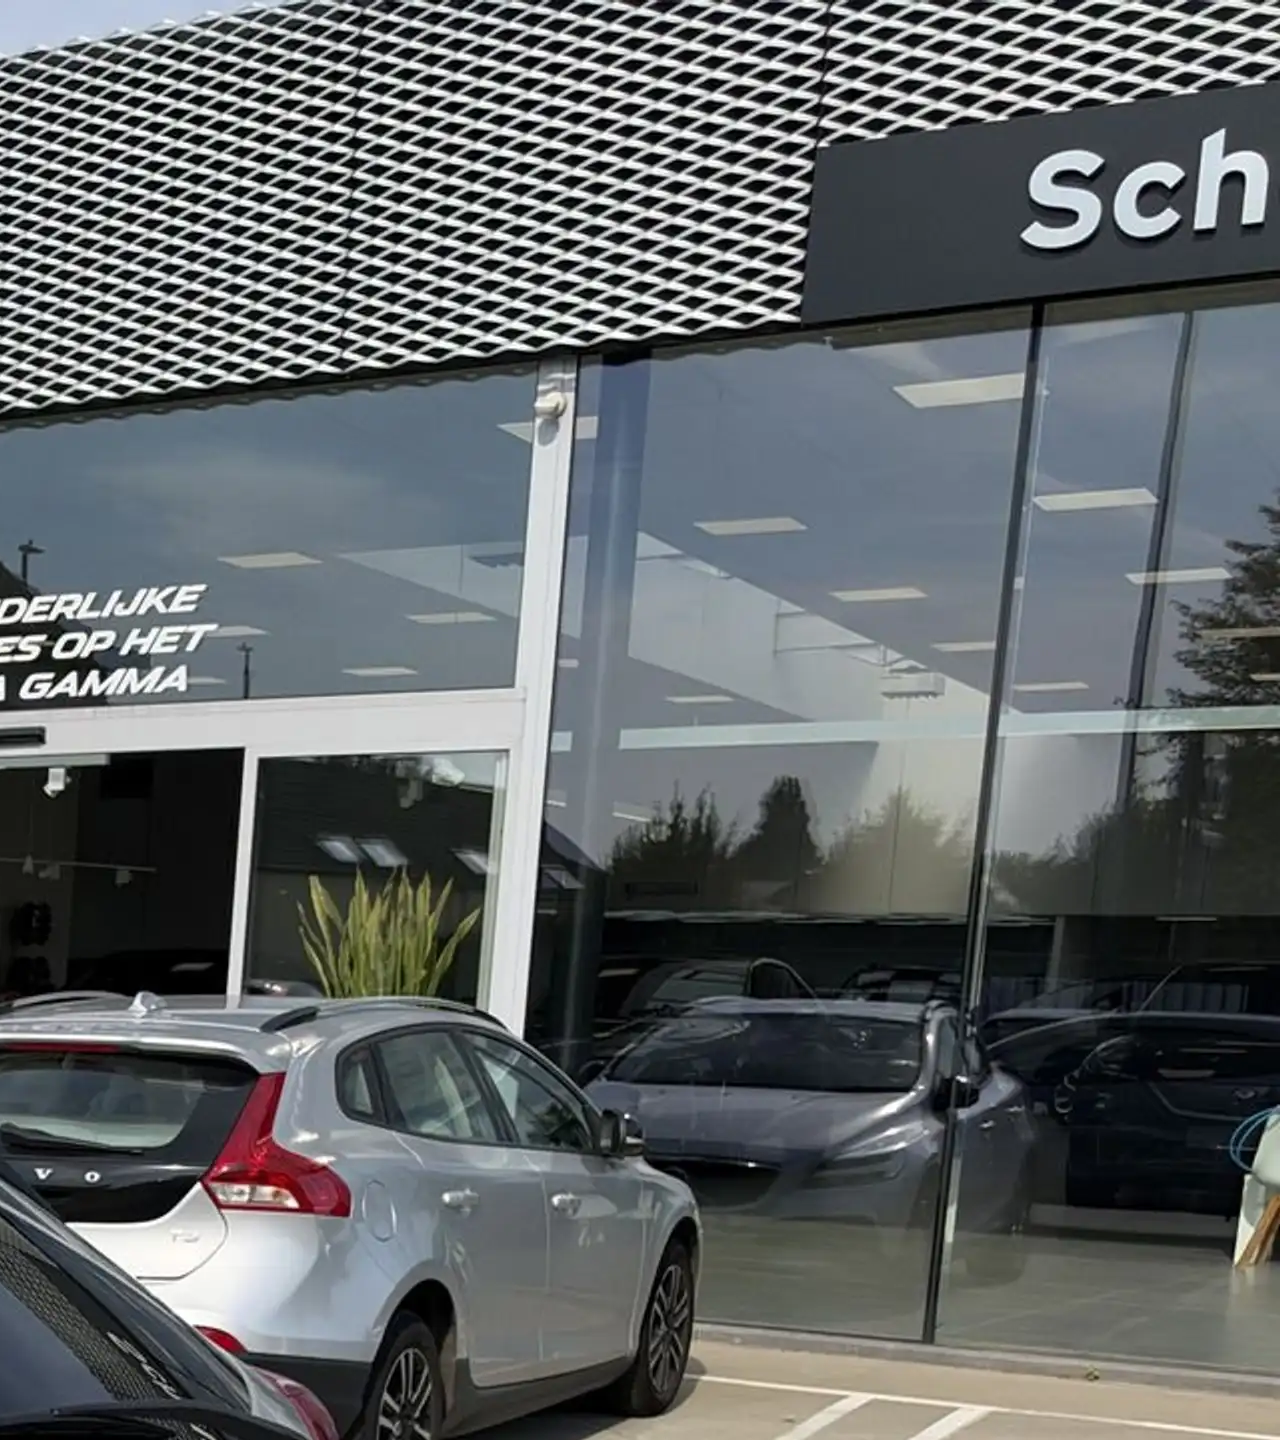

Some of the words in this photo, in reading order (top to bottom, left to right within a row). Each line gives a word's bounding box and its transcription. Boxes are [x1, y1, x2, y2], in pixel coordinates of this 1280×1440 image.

[1020, 127, 1269, 249] Sch
[51, 630, 116, 660] OP
[118, 623, 220, 657] HET
[18, 664, 189, 701] GAMMA
